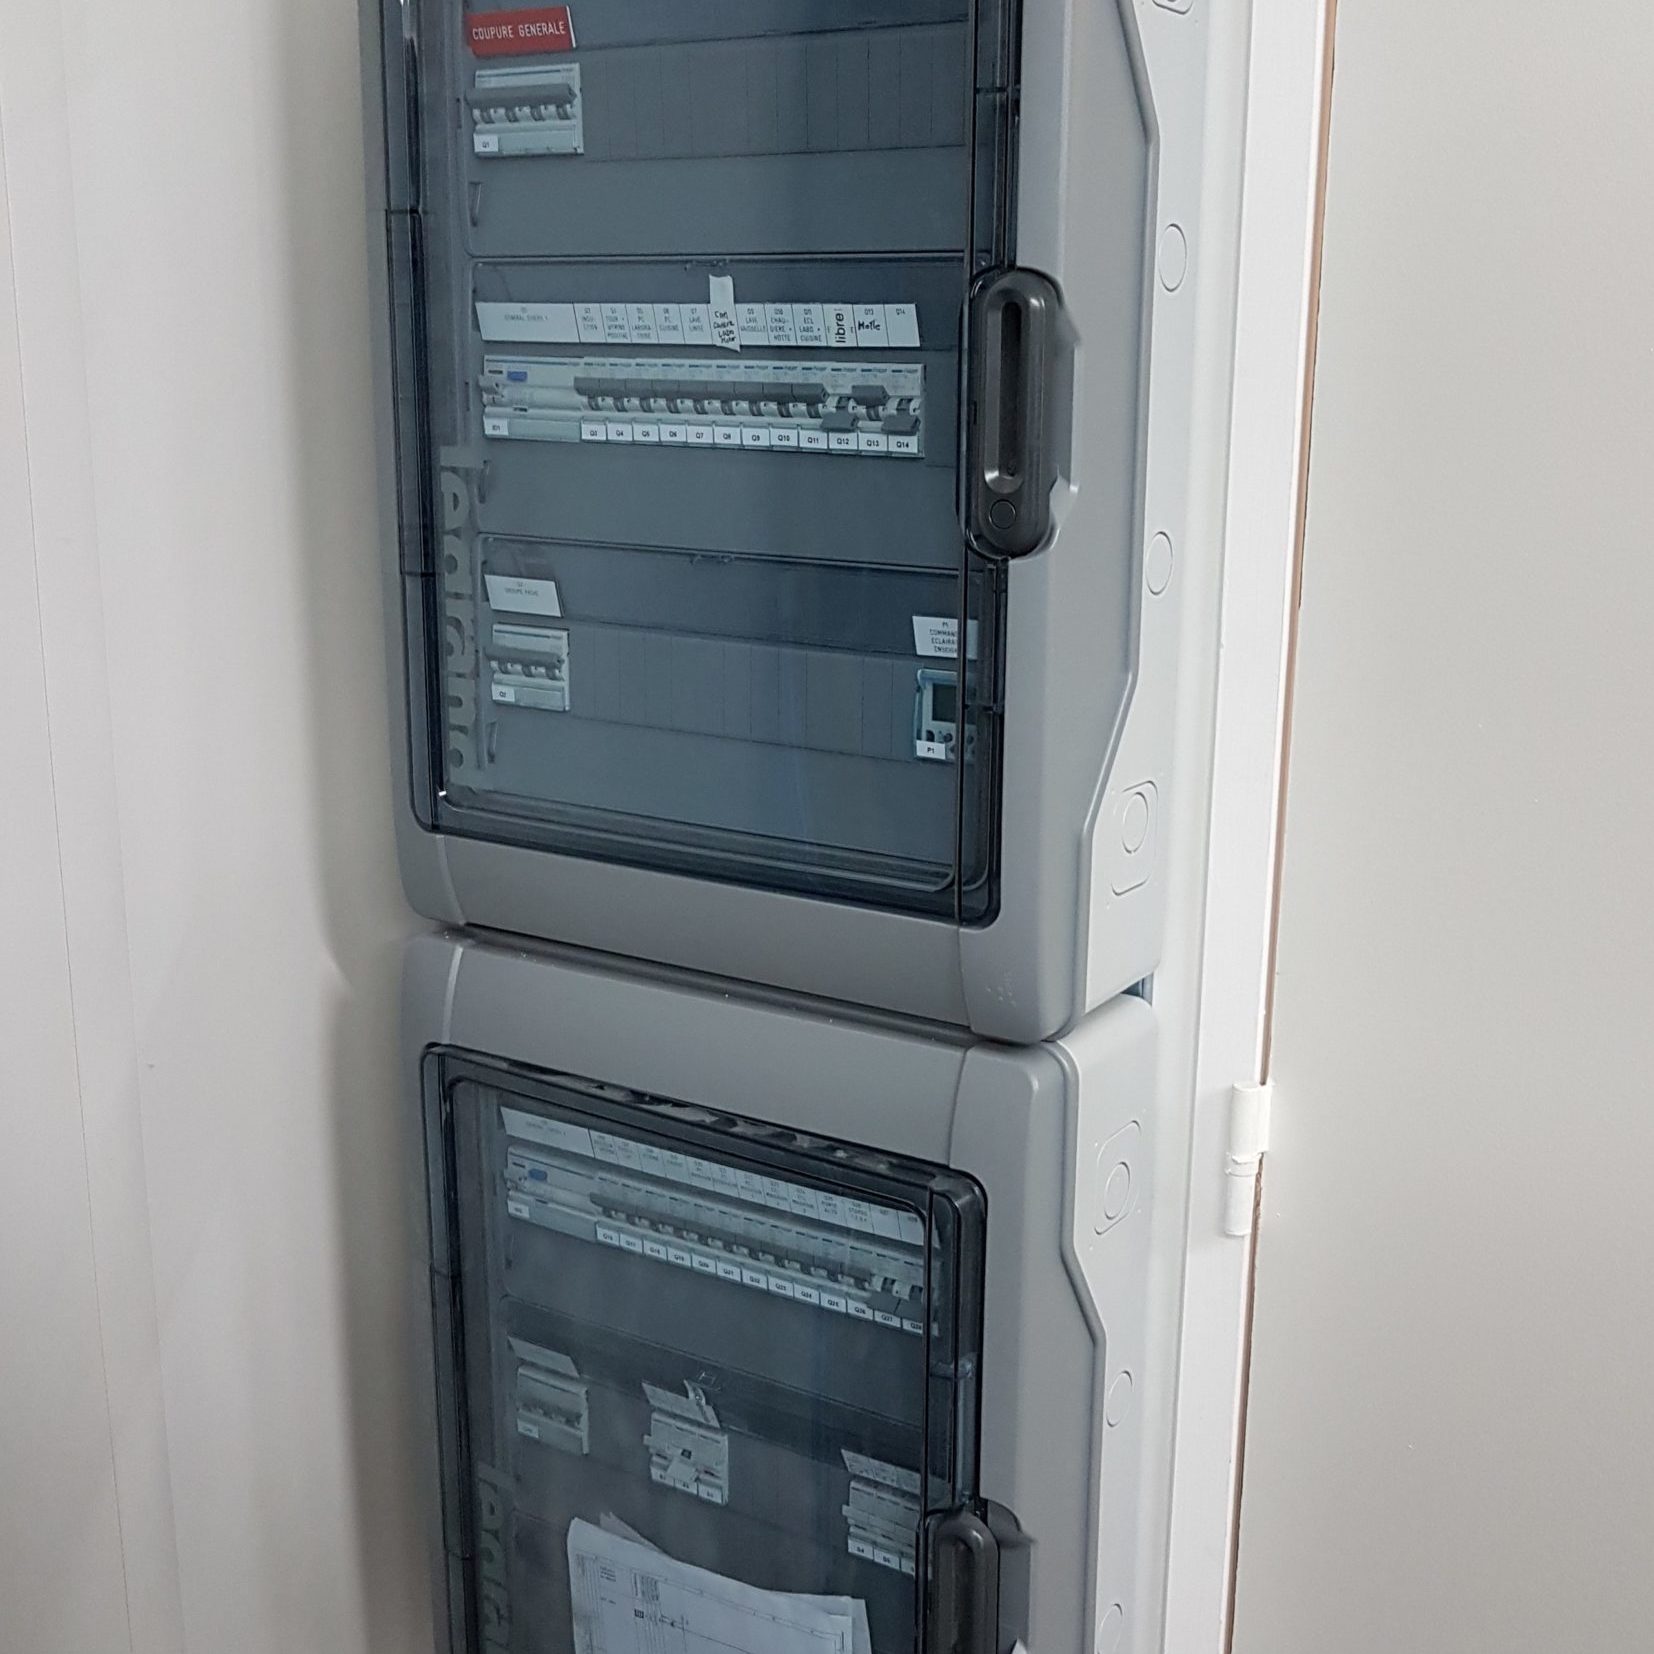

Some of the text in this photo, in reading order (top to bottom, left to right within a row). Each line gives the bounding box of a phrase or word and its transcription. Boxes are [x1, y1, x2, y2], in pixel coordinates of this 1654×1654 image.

[472, 21, 567, 40] COUPURE GENERALE
[835, 312, 846, 343] libre
[589, 429, 598, 437] Q3
[615, 429, 624, 437] Q4
[641, 430, 650, 438] Q5
[669, 430, 678, 438] Q6
[695, 432, 704, 440] Q7
[723, 433, 732, 441] Q8
[751, 434, 760, 442] Q9
[777, 434, 791, 442] Q10
[807, 436, 819, 445] Q11
[836, 437, 850, 445] Q12
[866, 439, 879, 447] Q13
[896, 440, 910, 449] Q14
[929, 628, 957, 637] COMMAN
[931, 637, 957, 645] ECLAIRA
